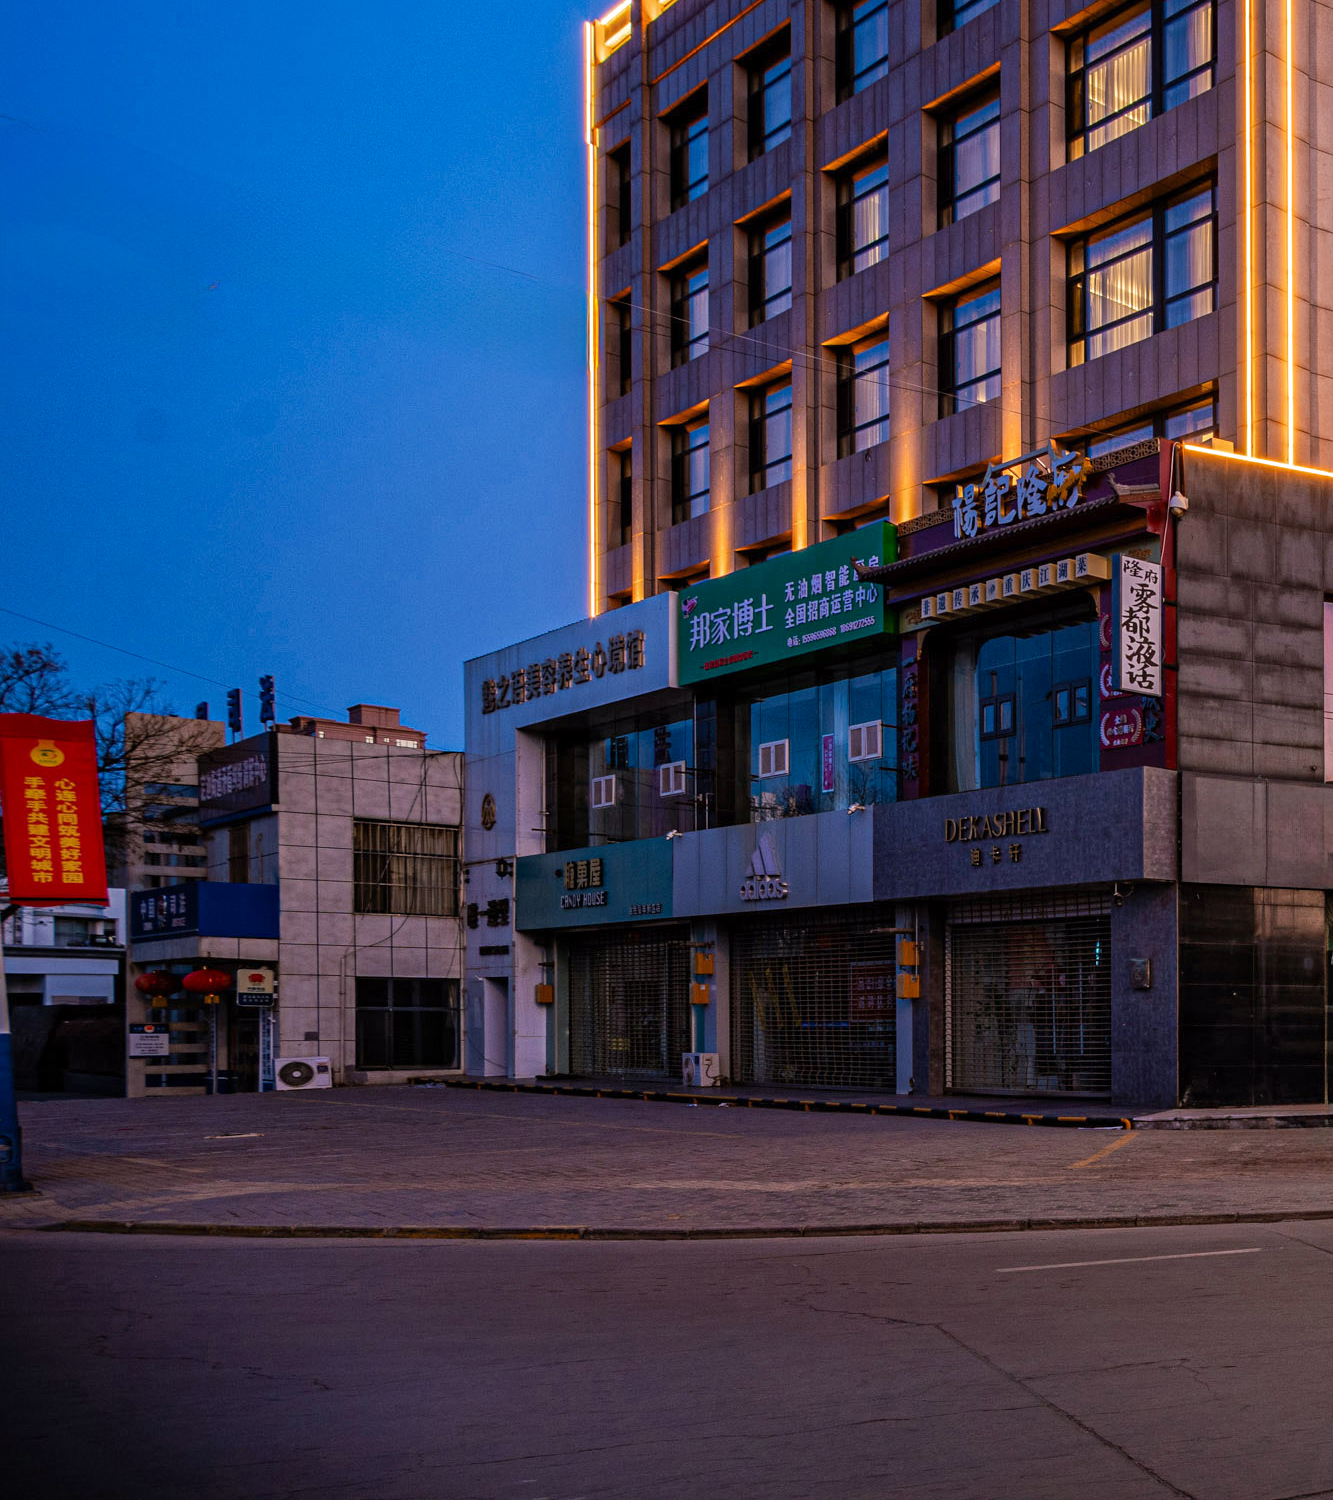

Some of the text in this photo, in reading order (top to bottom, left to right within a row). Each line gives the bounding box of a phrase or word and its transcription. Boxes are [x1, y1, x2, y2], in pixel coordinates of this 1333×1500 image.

[1123, 559, 1159, 585] 隆府
[689, 593, 775, 651] 邦家博士
[784, 584, 878, 630] 全国招商运营中心
[23, 776, 54, 884] 手牵手共建文明城市
[54, 777, 84, 884] 心连心同筑美好家园
[945, 807, 1048, 842] DEKASHELL
[560, 891, 606, 909] CANDY HOUSE
[740, 876, 788, 901] adidas
